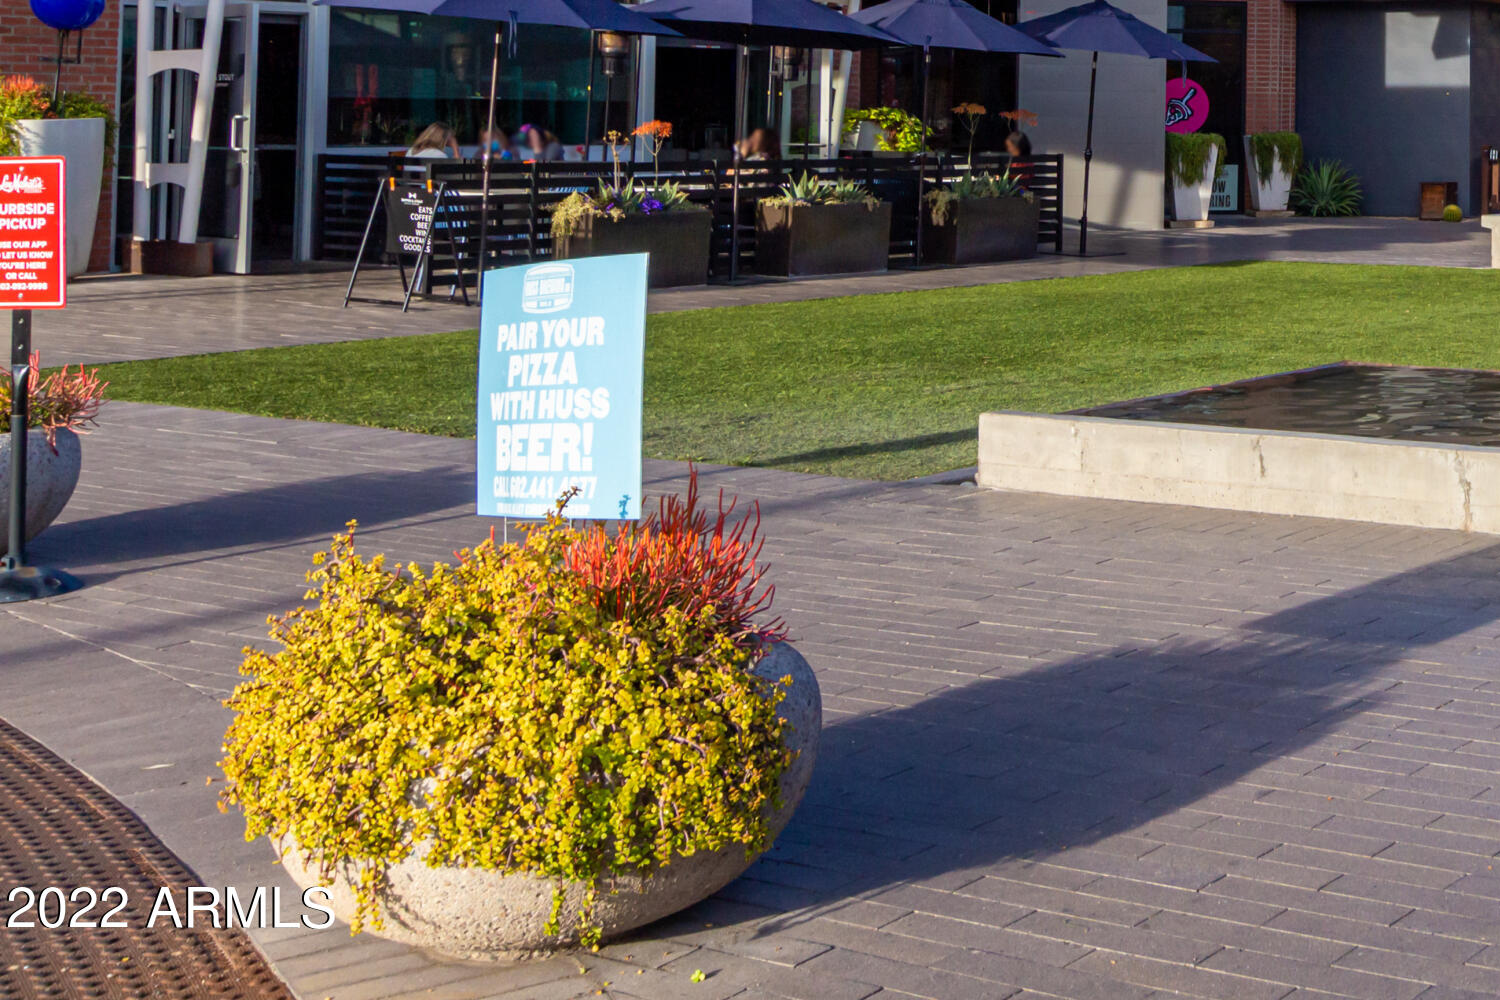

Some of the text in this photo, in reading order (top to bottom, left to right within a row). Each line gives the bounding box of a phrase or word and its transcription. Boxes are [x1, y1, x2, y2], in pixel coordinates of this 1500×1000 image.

[1211, 180, 1226, 193] OW
[1209, 194, 1231, 208] RING
[0, 202, 55, 215] URBSIDE
[0, 217, 46, 230] PICKUP
[417, 221, 430, 230] BEE
[12, 240, 30, 249] OUR
[31, 240, 48, 249] APP
[28, 250, 53, 259] KNOW
[5, 272, 38, 280] OR CALL
[497, 316, 605, 352] PAIR YOUR
[507, 351, 578, 388] PIZZA
[490, 387, 610, 421] WITH HUSS
[495, 422, 595, 473] BEER!
[493, 476, 509, 497] CALL
